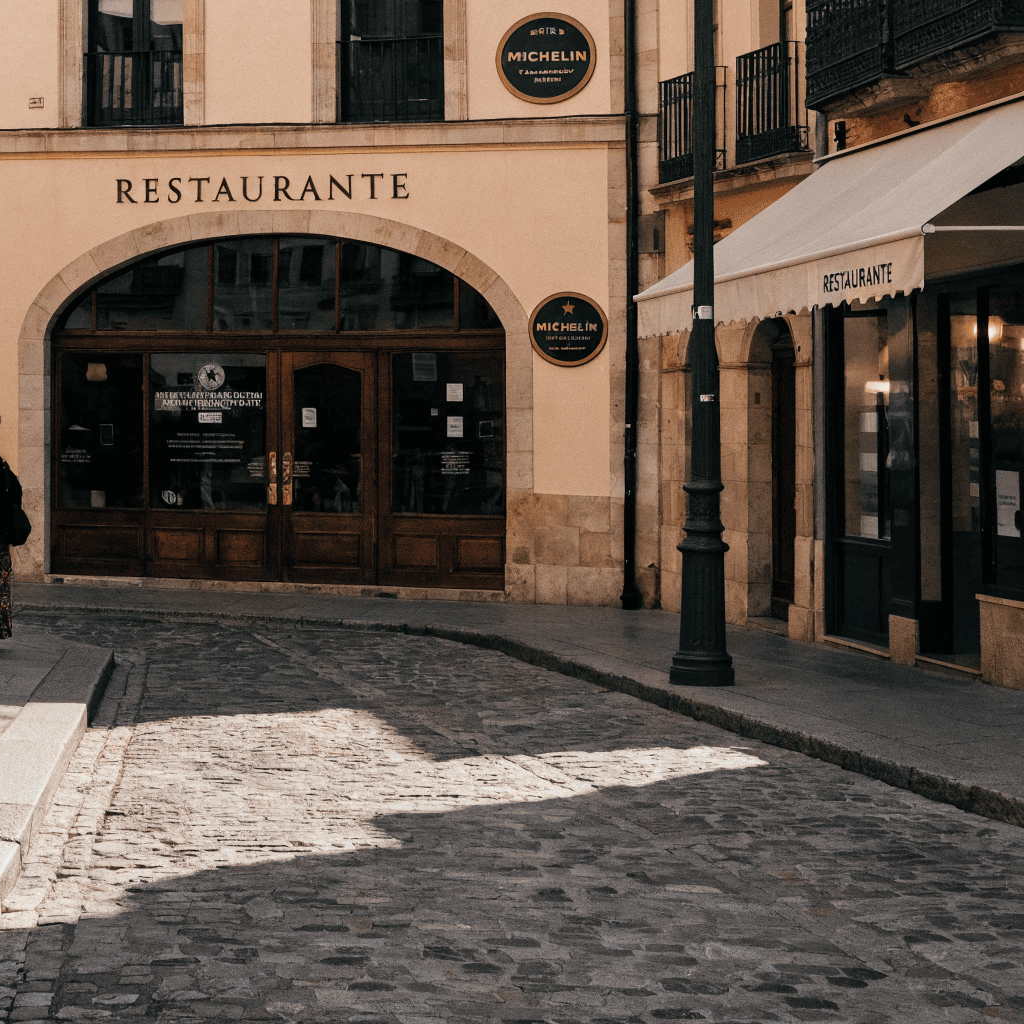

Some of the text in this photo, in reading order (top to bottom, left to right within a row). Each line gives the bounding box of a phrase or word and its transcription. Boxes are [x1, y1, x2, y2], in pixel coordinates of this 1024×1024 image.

[507, 50, 587, 62] MICHELIN
[116, 172, 410, 204] RESTAURANTE
[823, 262, 893, 293] RESTAURANTE
